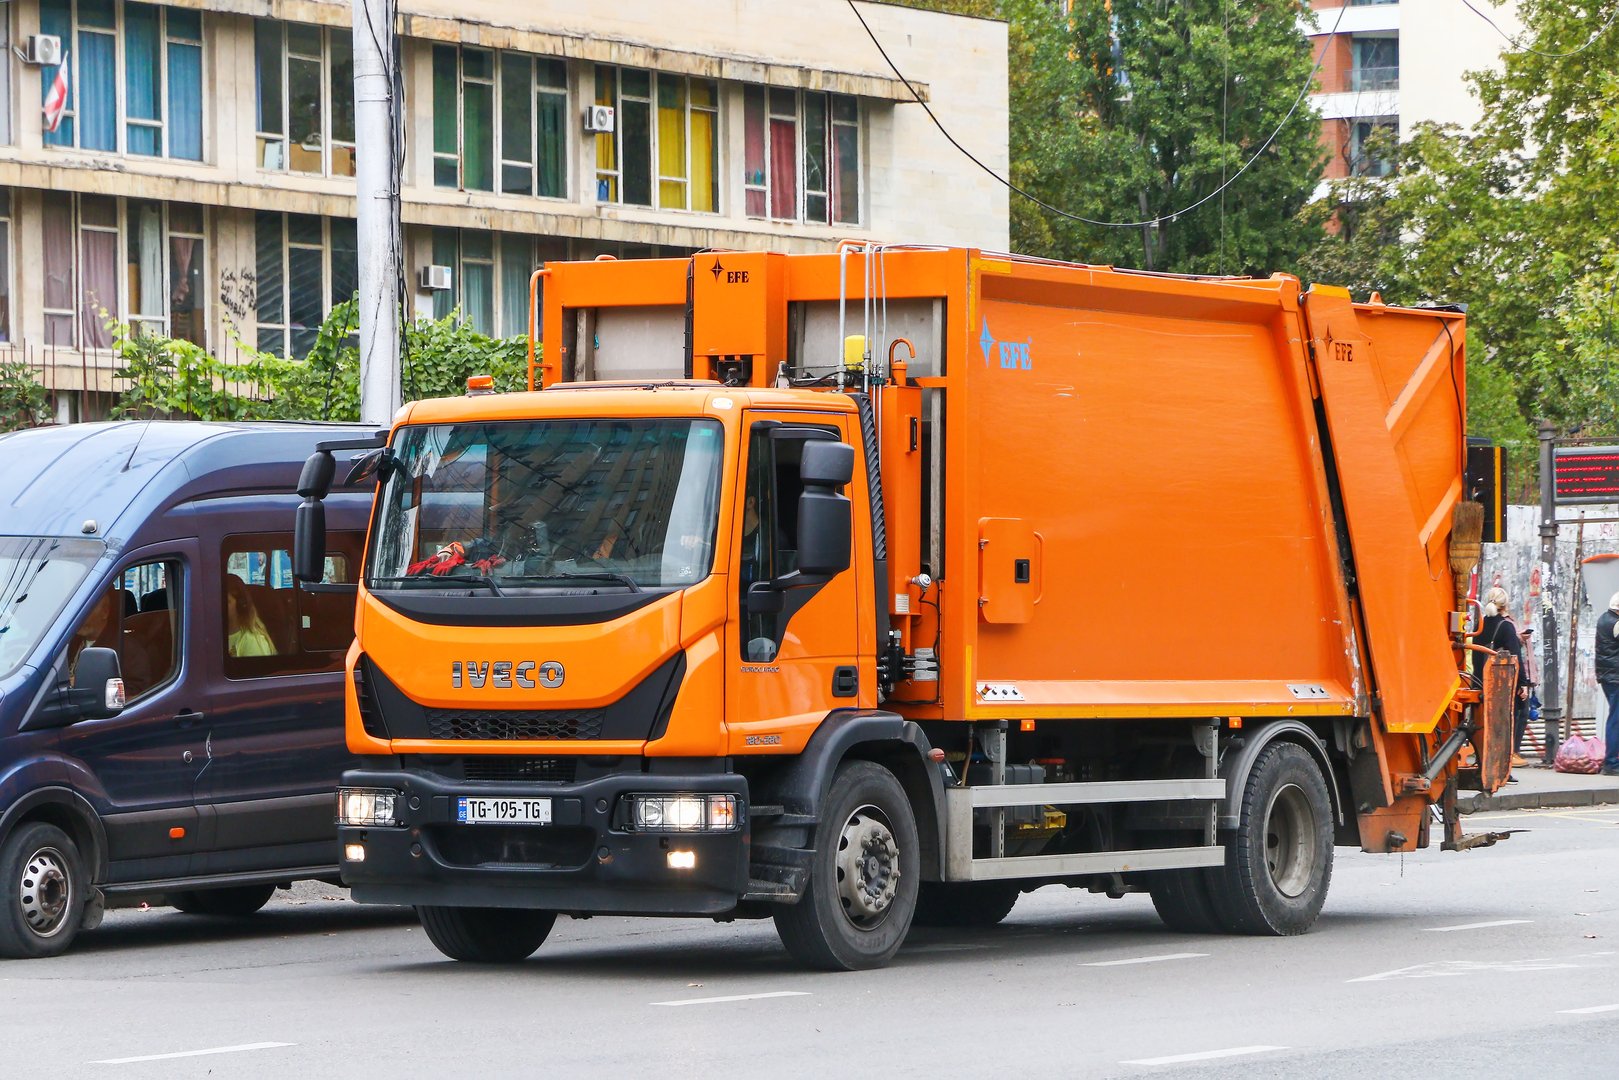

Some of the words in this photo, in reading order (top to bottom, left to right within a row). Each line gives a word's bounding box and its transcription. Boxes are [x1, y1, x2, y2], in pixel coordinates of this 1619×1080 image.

[727, 271, 749, 283] EFE
[999, 341, 1032, 370] EFE
[452, 661, 565, 688] IVECO
[469, 801, 541, 819] TG-195-TG
